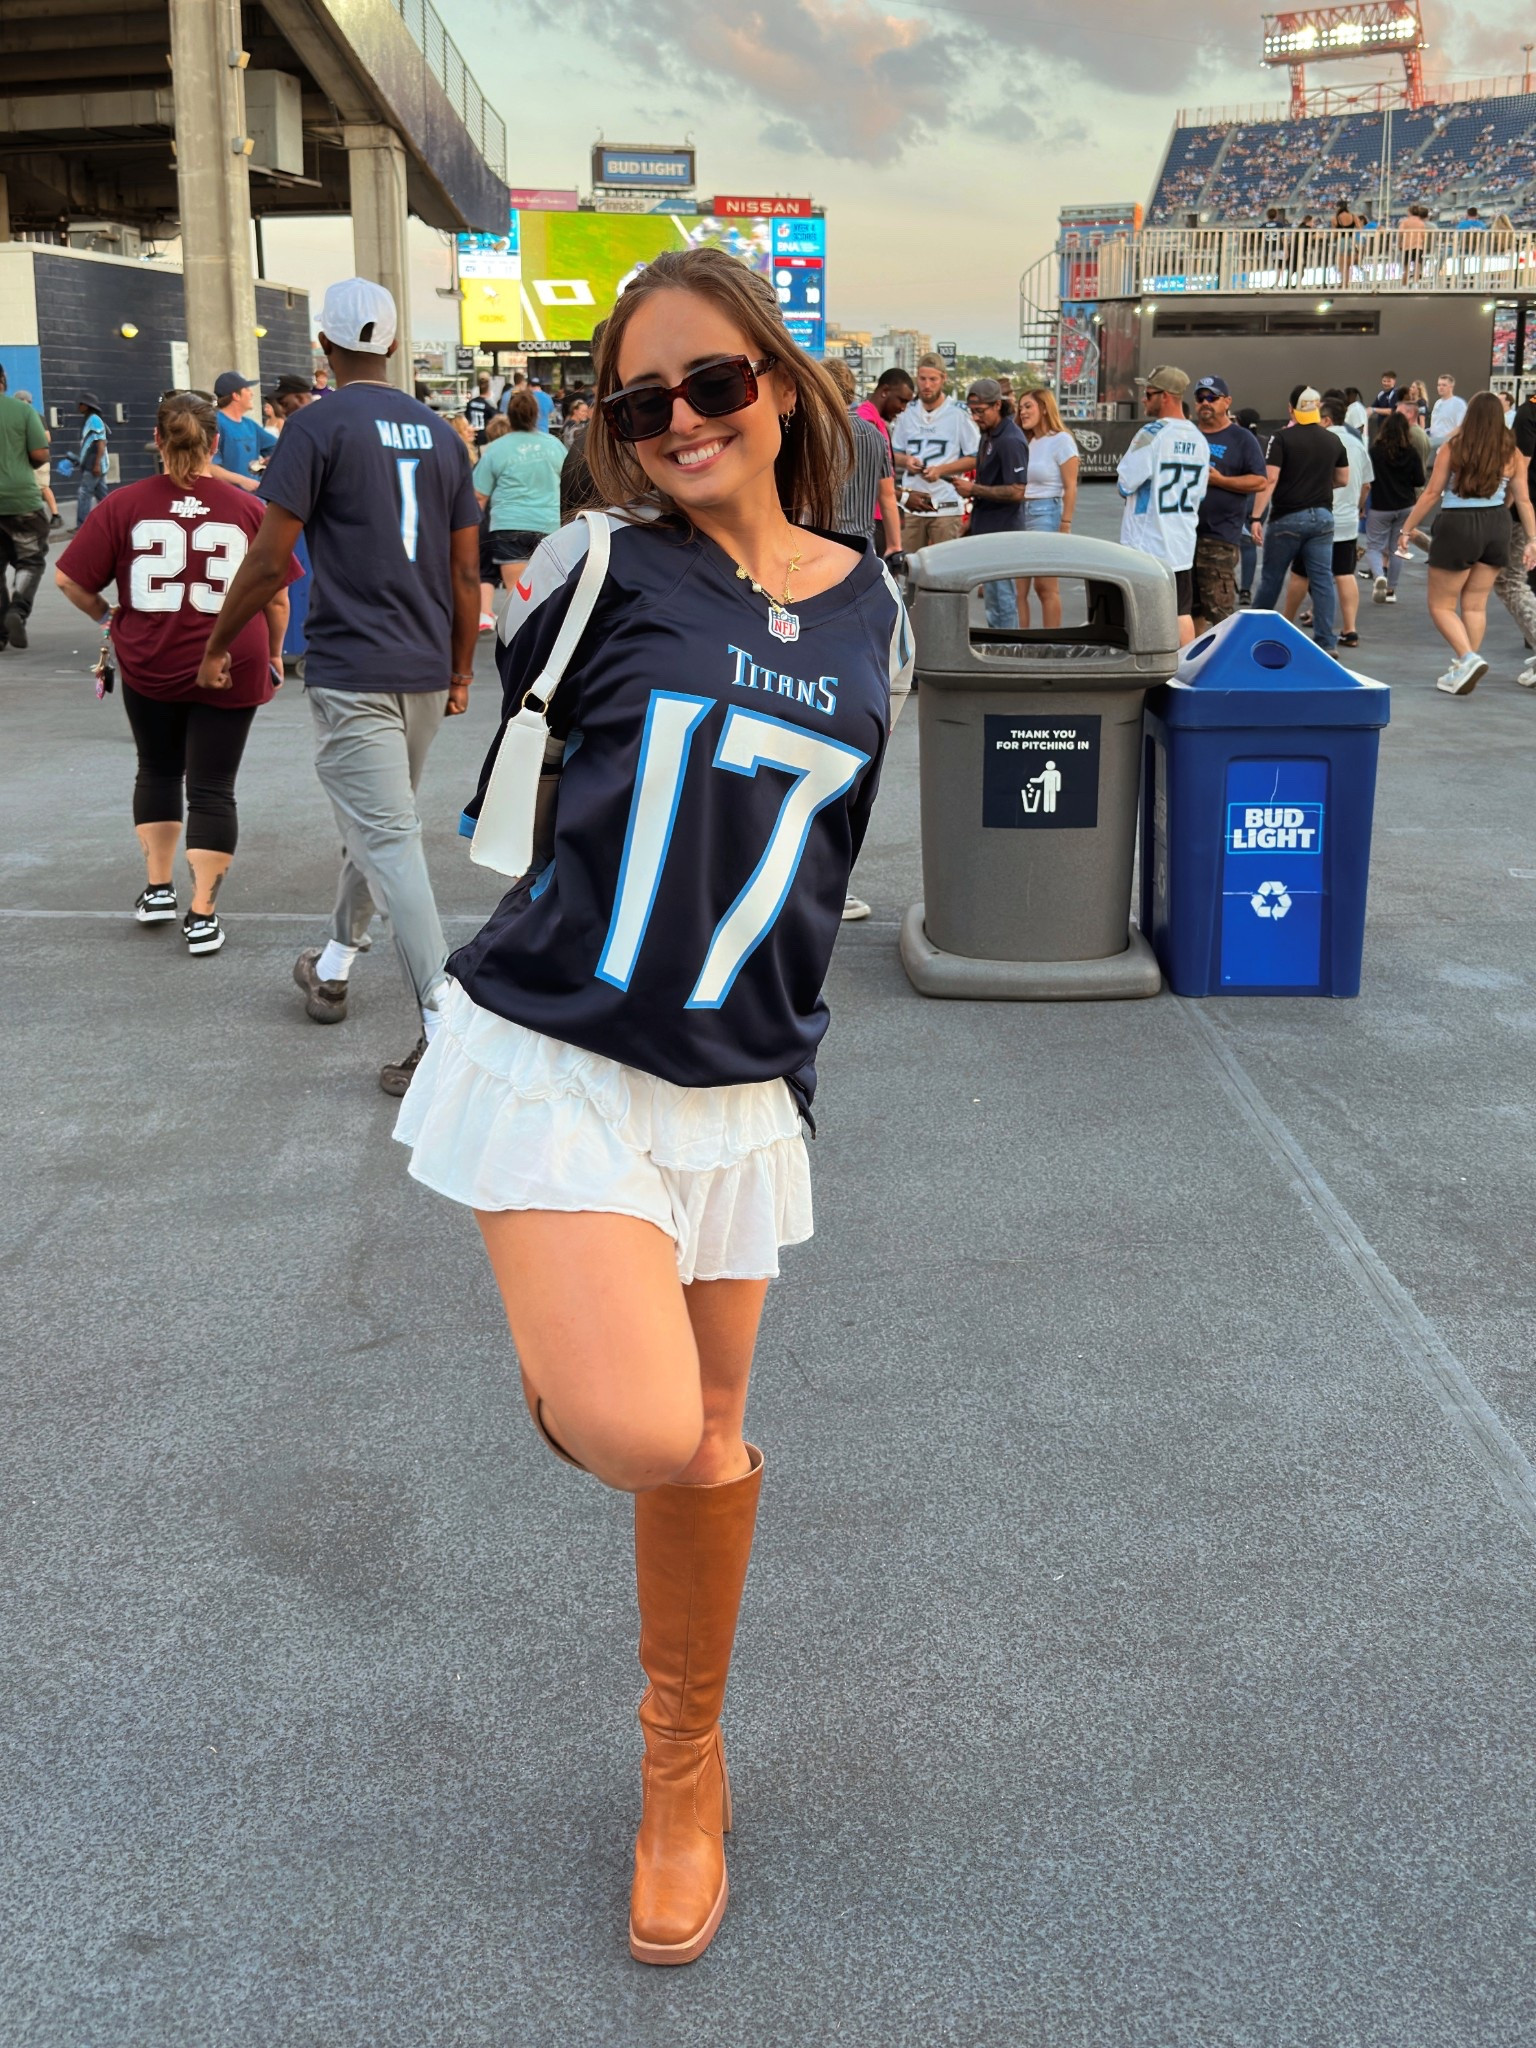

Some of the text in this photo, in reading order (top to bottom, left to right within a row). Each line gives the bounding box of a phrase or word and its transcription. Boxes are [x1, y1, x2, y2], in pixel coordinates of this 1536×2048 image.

[607, 160, 686, 176] BUD LIGHT
[726, 201, 800, 214] NISSAN
[518, 341, 572, 351] COCKTAILS
[375, 419, 433, 450] WARD
[1173, 441, 1196, 456] HENRY
[1079, 453, 1122, 465] EMIUM
[1159, 462, 1205, 514] 22
[169, 500, 210, 518] Pepper
[184, 496, 202, 508] Dr
[396, 458, 420, 563] 1
[130, 519, 249, 614] 23
[774, 620, 795, 637] NFL
[1010, 729, 1077, 739] THANK YOU
[996, 741, 1090, 750] FOR PITCHING IN
[1244, 808, 1305, 828] BUD
[1232, 828, 1316, 849] LIGHT
[594, 688, 871, 1010] 17
